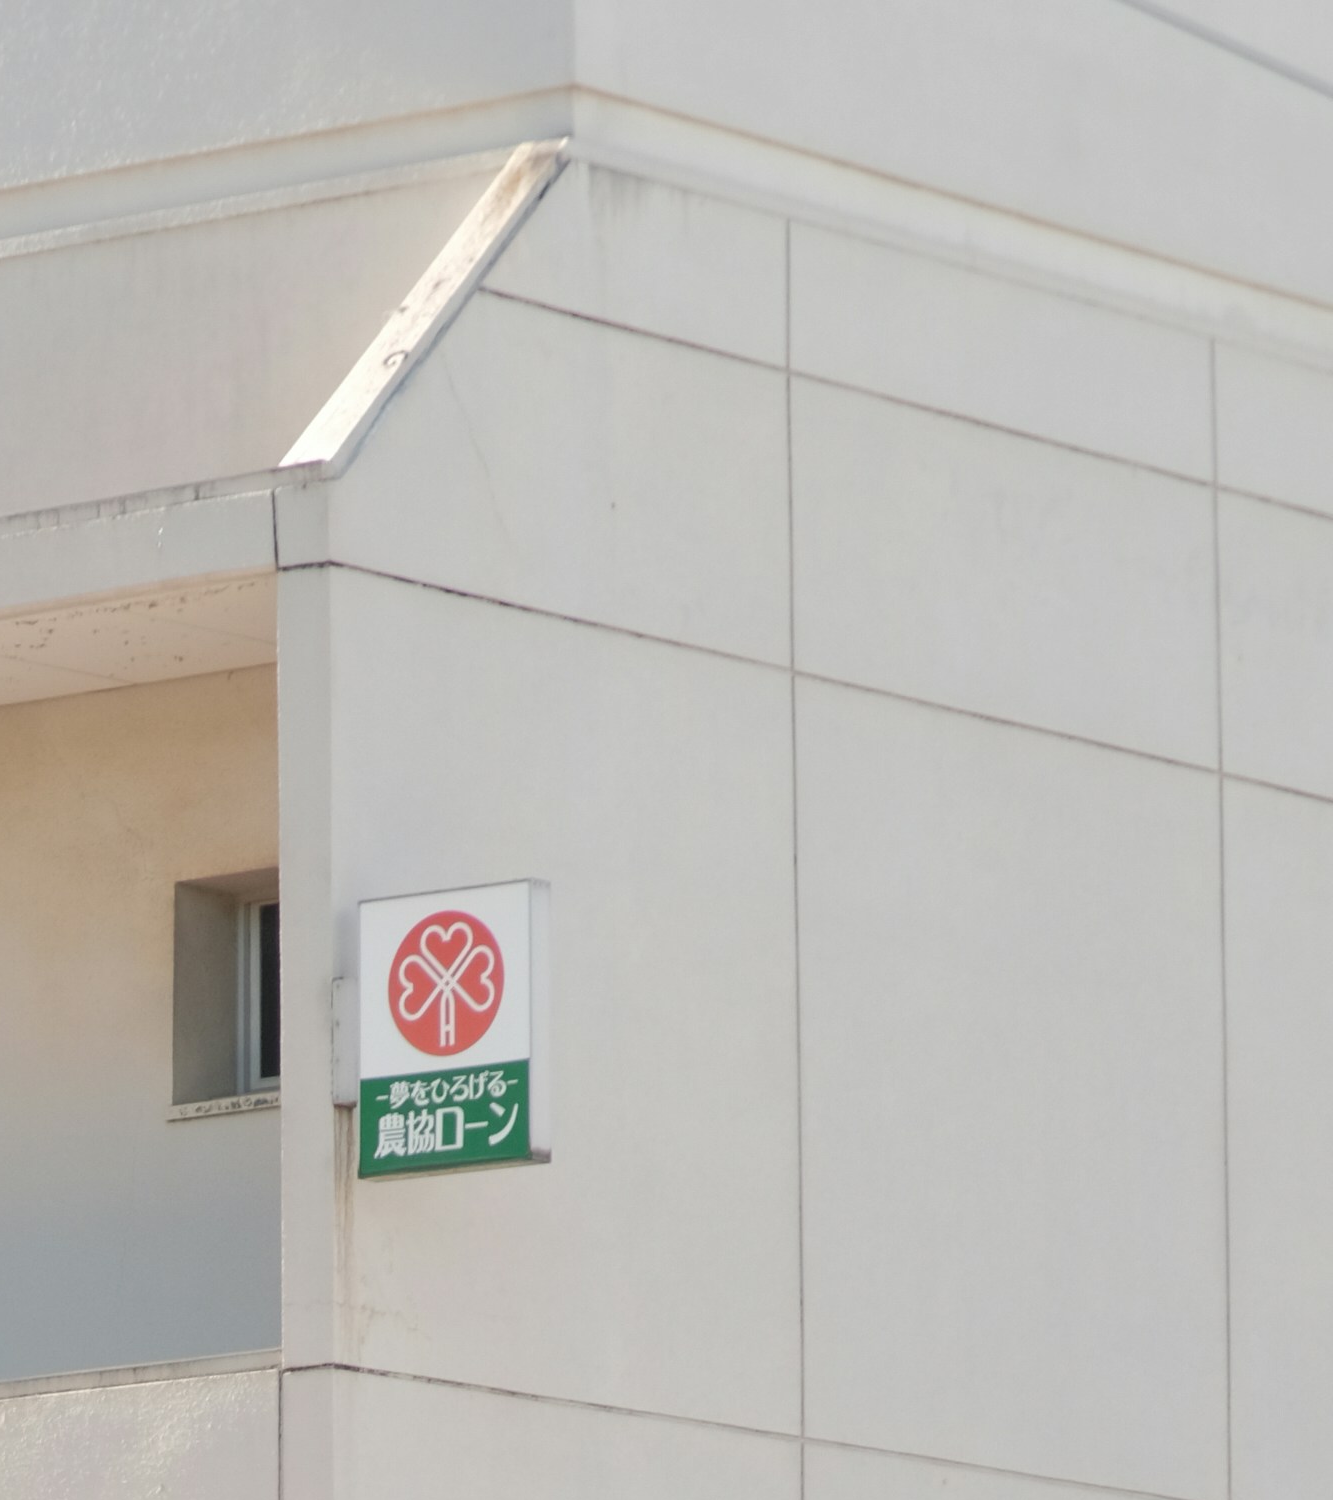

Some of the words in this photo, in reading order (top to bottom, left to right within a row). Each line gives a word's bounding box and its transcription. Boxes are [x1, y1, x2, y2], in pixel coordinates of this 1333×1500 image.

[374, 1102, 519, 1159] 農協ローン
